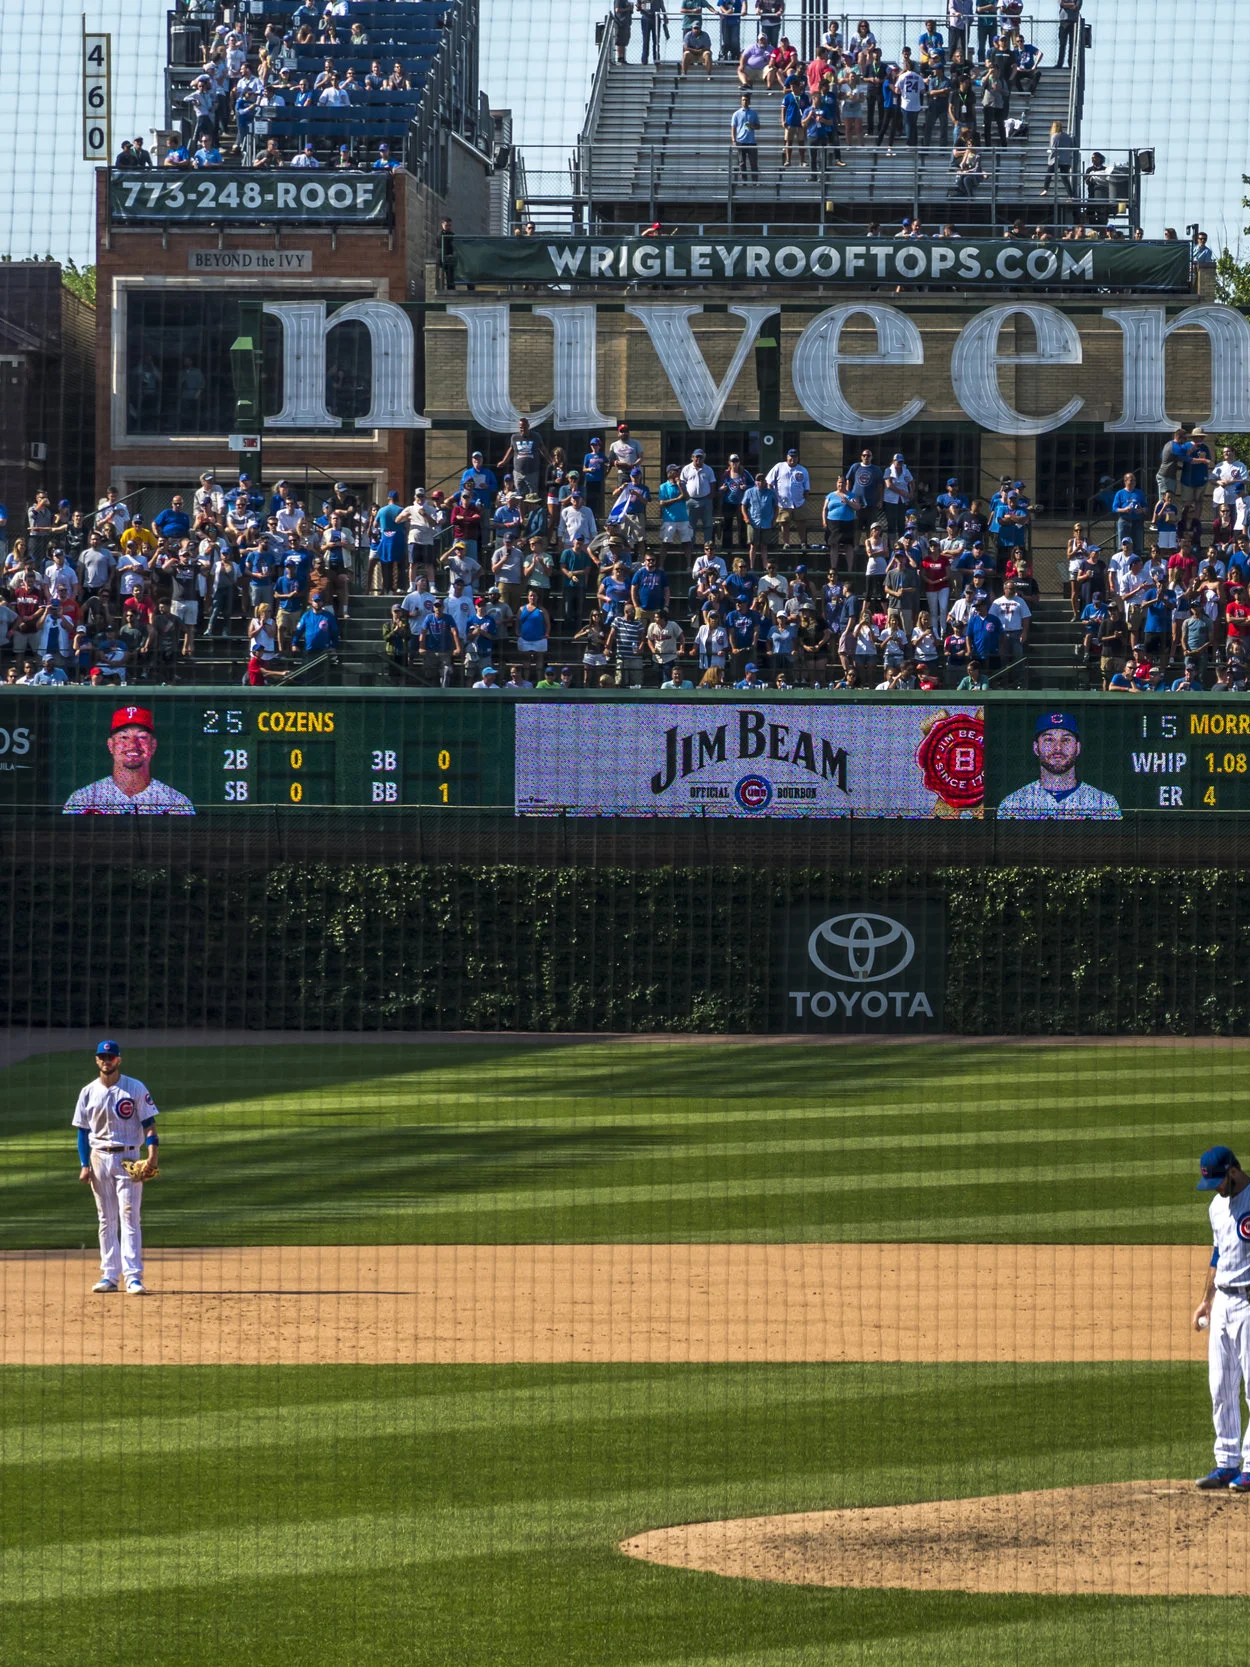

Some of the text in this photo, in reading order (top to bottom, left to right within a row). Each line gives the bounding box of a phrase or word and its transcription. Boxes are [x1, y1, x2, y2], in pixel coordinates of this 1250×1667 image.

[905, 80, 919, 93] 24
[122, 181, 375, 209] 773-248-ROOF
[195, 252, 306, 269] BEYOND the IVY
[547, 245, 1094, 281] WRIGLEYROOFTOPS.COM
[203, 710, 243, 733] 25
[257, 711, 335, 733] COZENS
[1142, 715, 1178, 738] 15
[651, 710, 851, 795] JIM BEAM
[938, 733, 955, 752] JIM
[223, 749, 249, 770] 2B
[290, 749, 303, 769] 0
[371, 750, 398, 771] 3B
[437, 749, 451, 770] 0
[1131, 752, 1188, 774] WHIP
[1204, 753, 1248, 774] 1.08
[935, 762, 967, 789] SINCE
[224, 781, 249, 801] SB
[290, 782, 303, 802] 0
[372, 781, 398, 802] BB
[438, 782, 449, 803] 1
[689, 787, 730, 799] OFFICIAL
[777, 787, 817, 799] BOURBON
[1159, 786, 1184, 807] ER
[1203, 786, 1217, 807] 4
[788, 990, 935, 1018] TOYOTA
